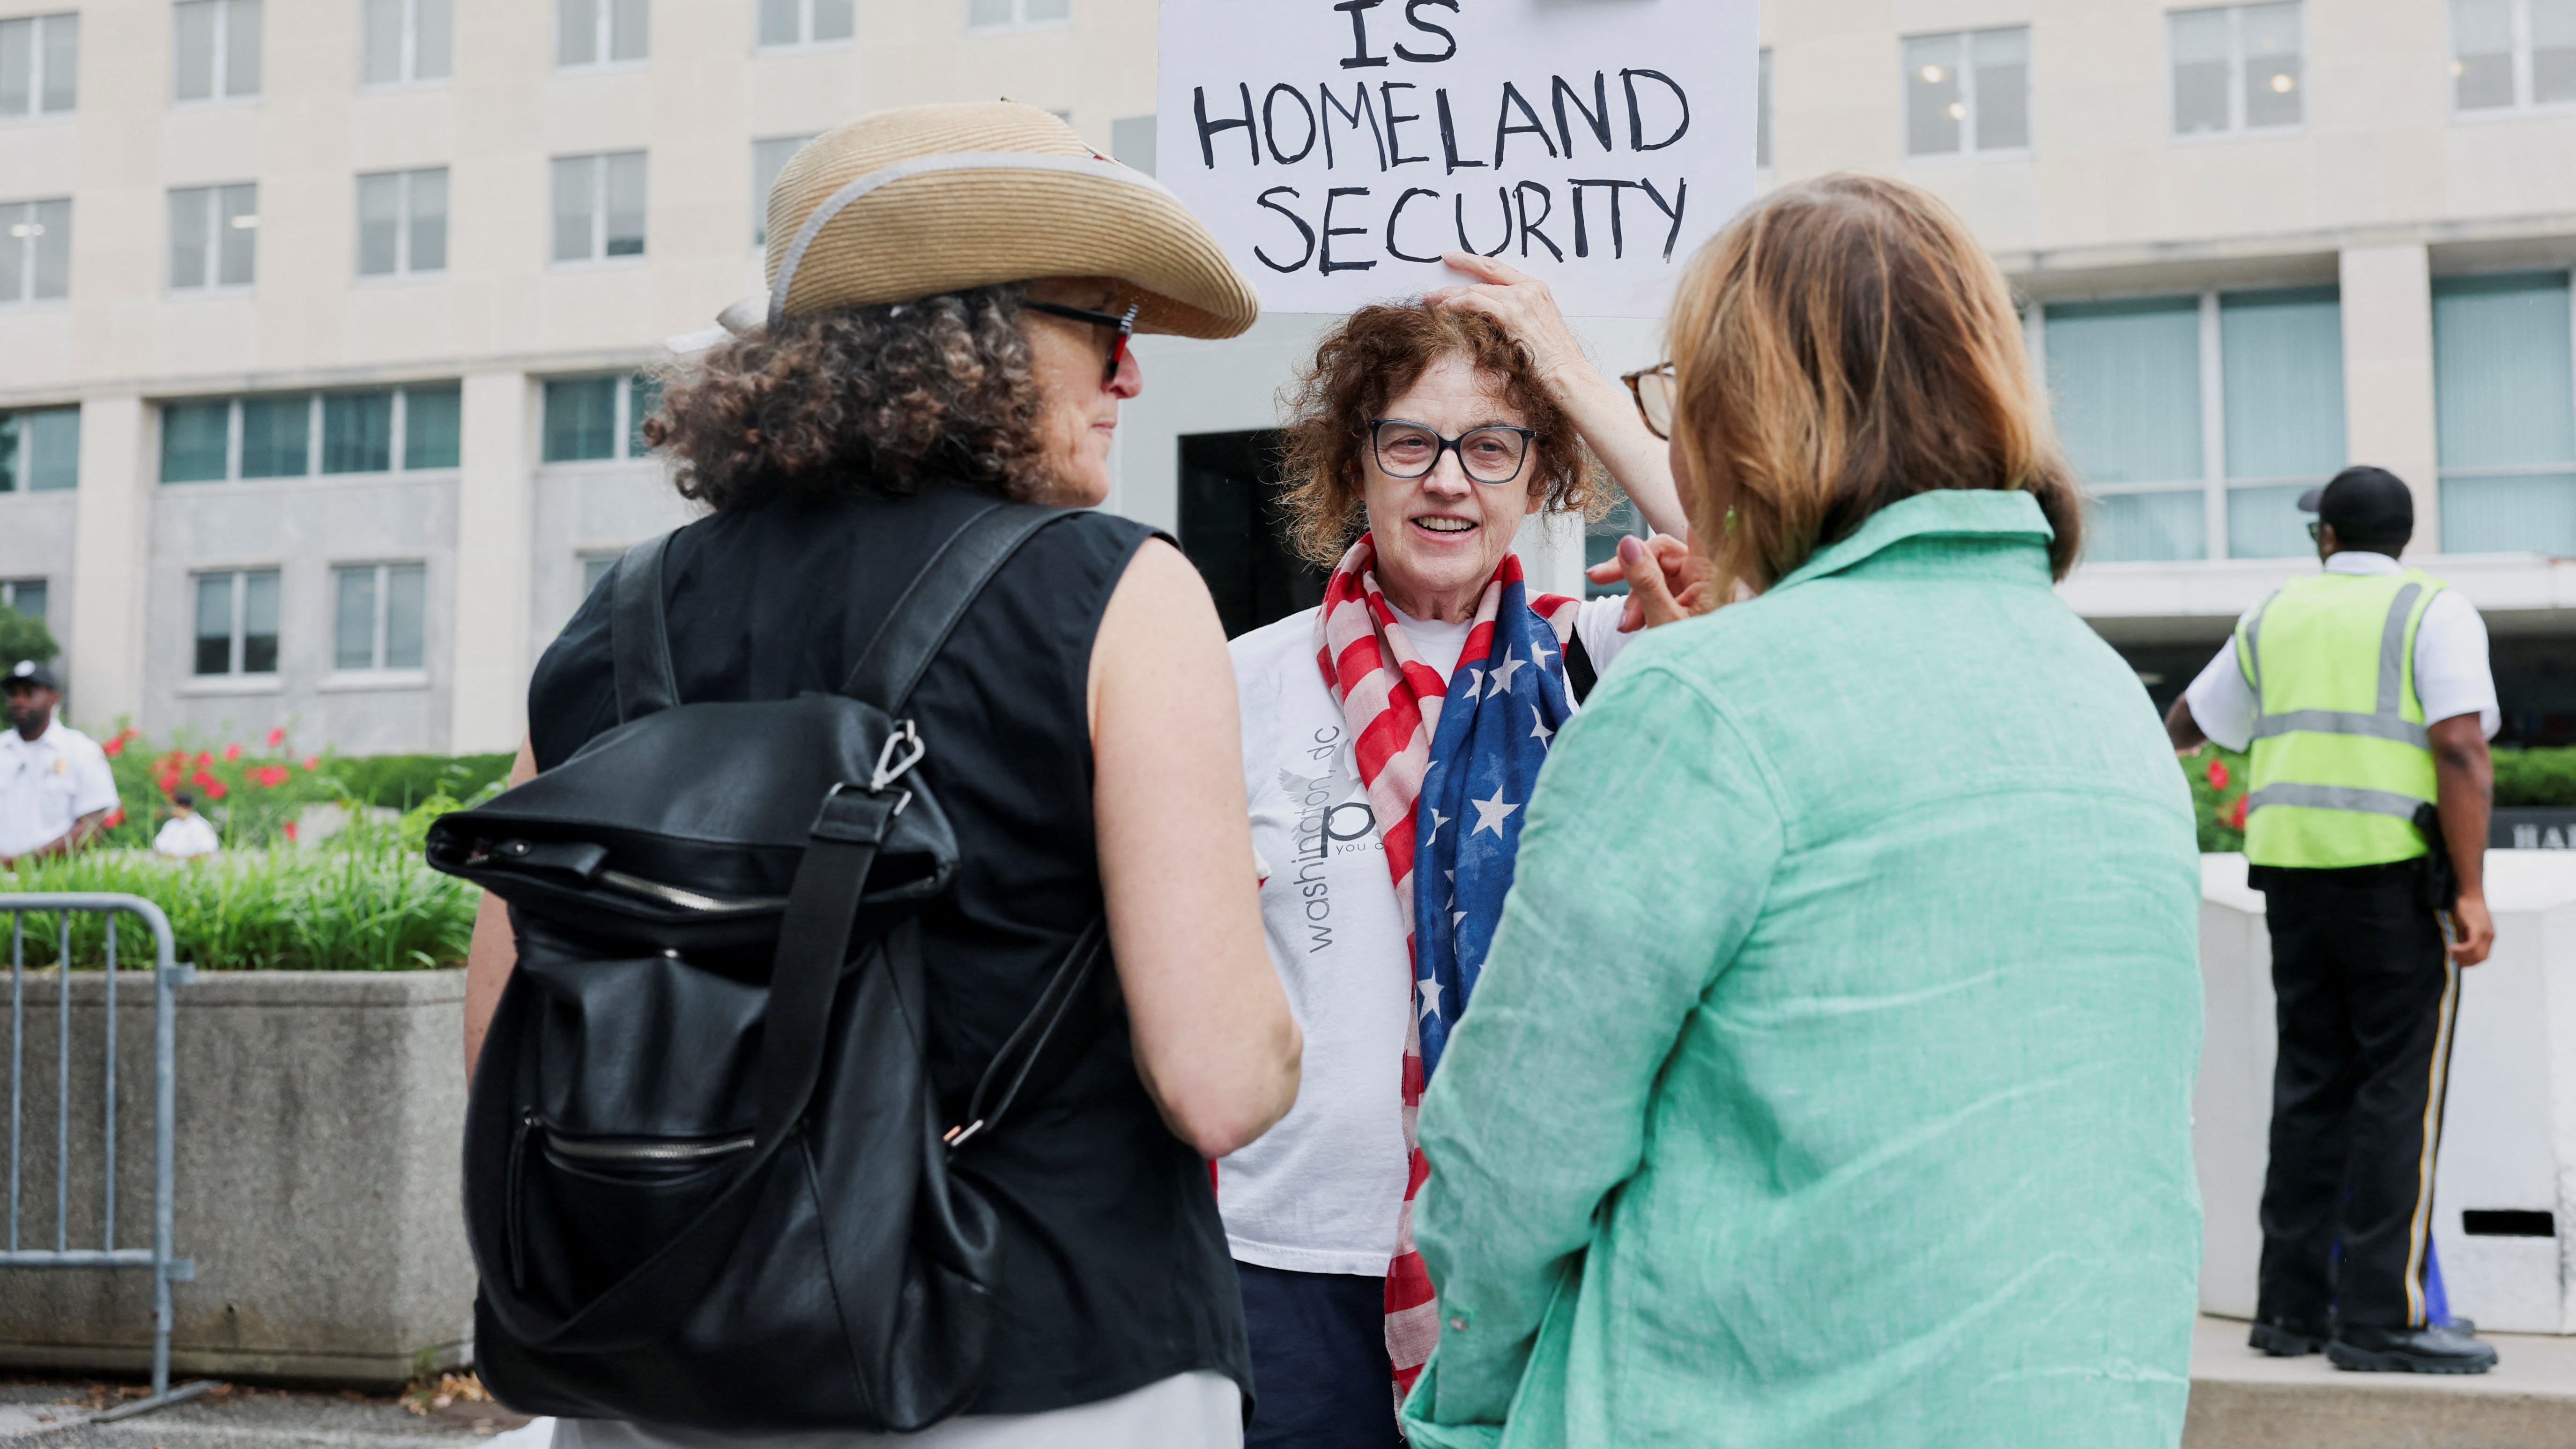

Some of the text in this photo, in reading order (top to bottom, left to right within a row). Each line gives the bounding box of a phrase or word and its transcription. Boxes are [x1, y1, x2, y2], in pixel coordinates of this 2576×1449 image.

[1333, 0, 1461, 68] IS
[1193, 68, 1690, 175] HOMELAND
[1254, 177, 1687, 276] SECURITY
[1307, 726, 1340, 760] dc
[1336, 844, 1365, 855] you
